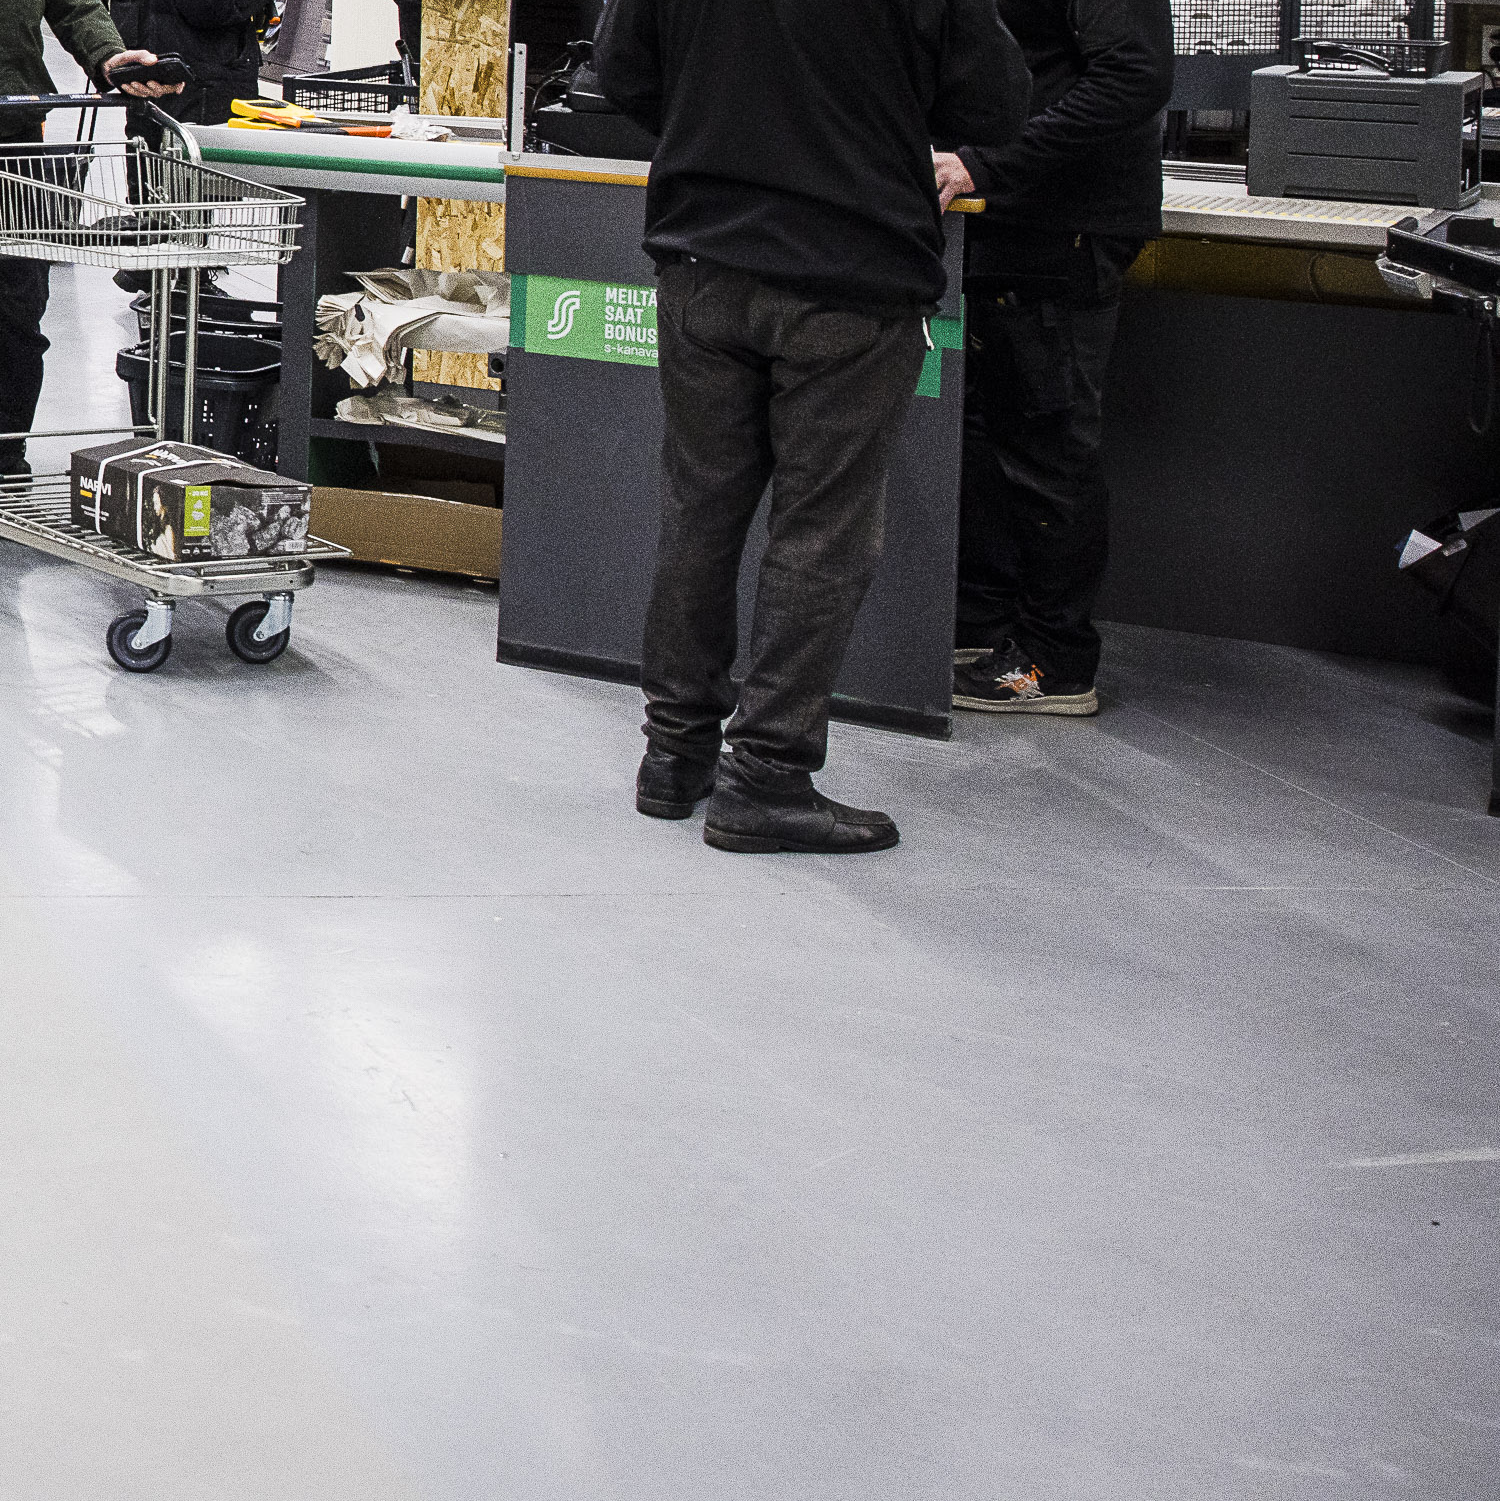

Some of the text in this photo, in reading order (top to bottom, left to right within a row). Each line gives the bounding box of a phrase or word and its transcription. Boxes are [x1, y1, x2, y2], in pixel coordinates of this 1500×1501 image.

[605, 286, 658, 307] MEILTÄ
[604, 305, 645, 325] SAAT
[604, 323, 658, 345] BONUS
